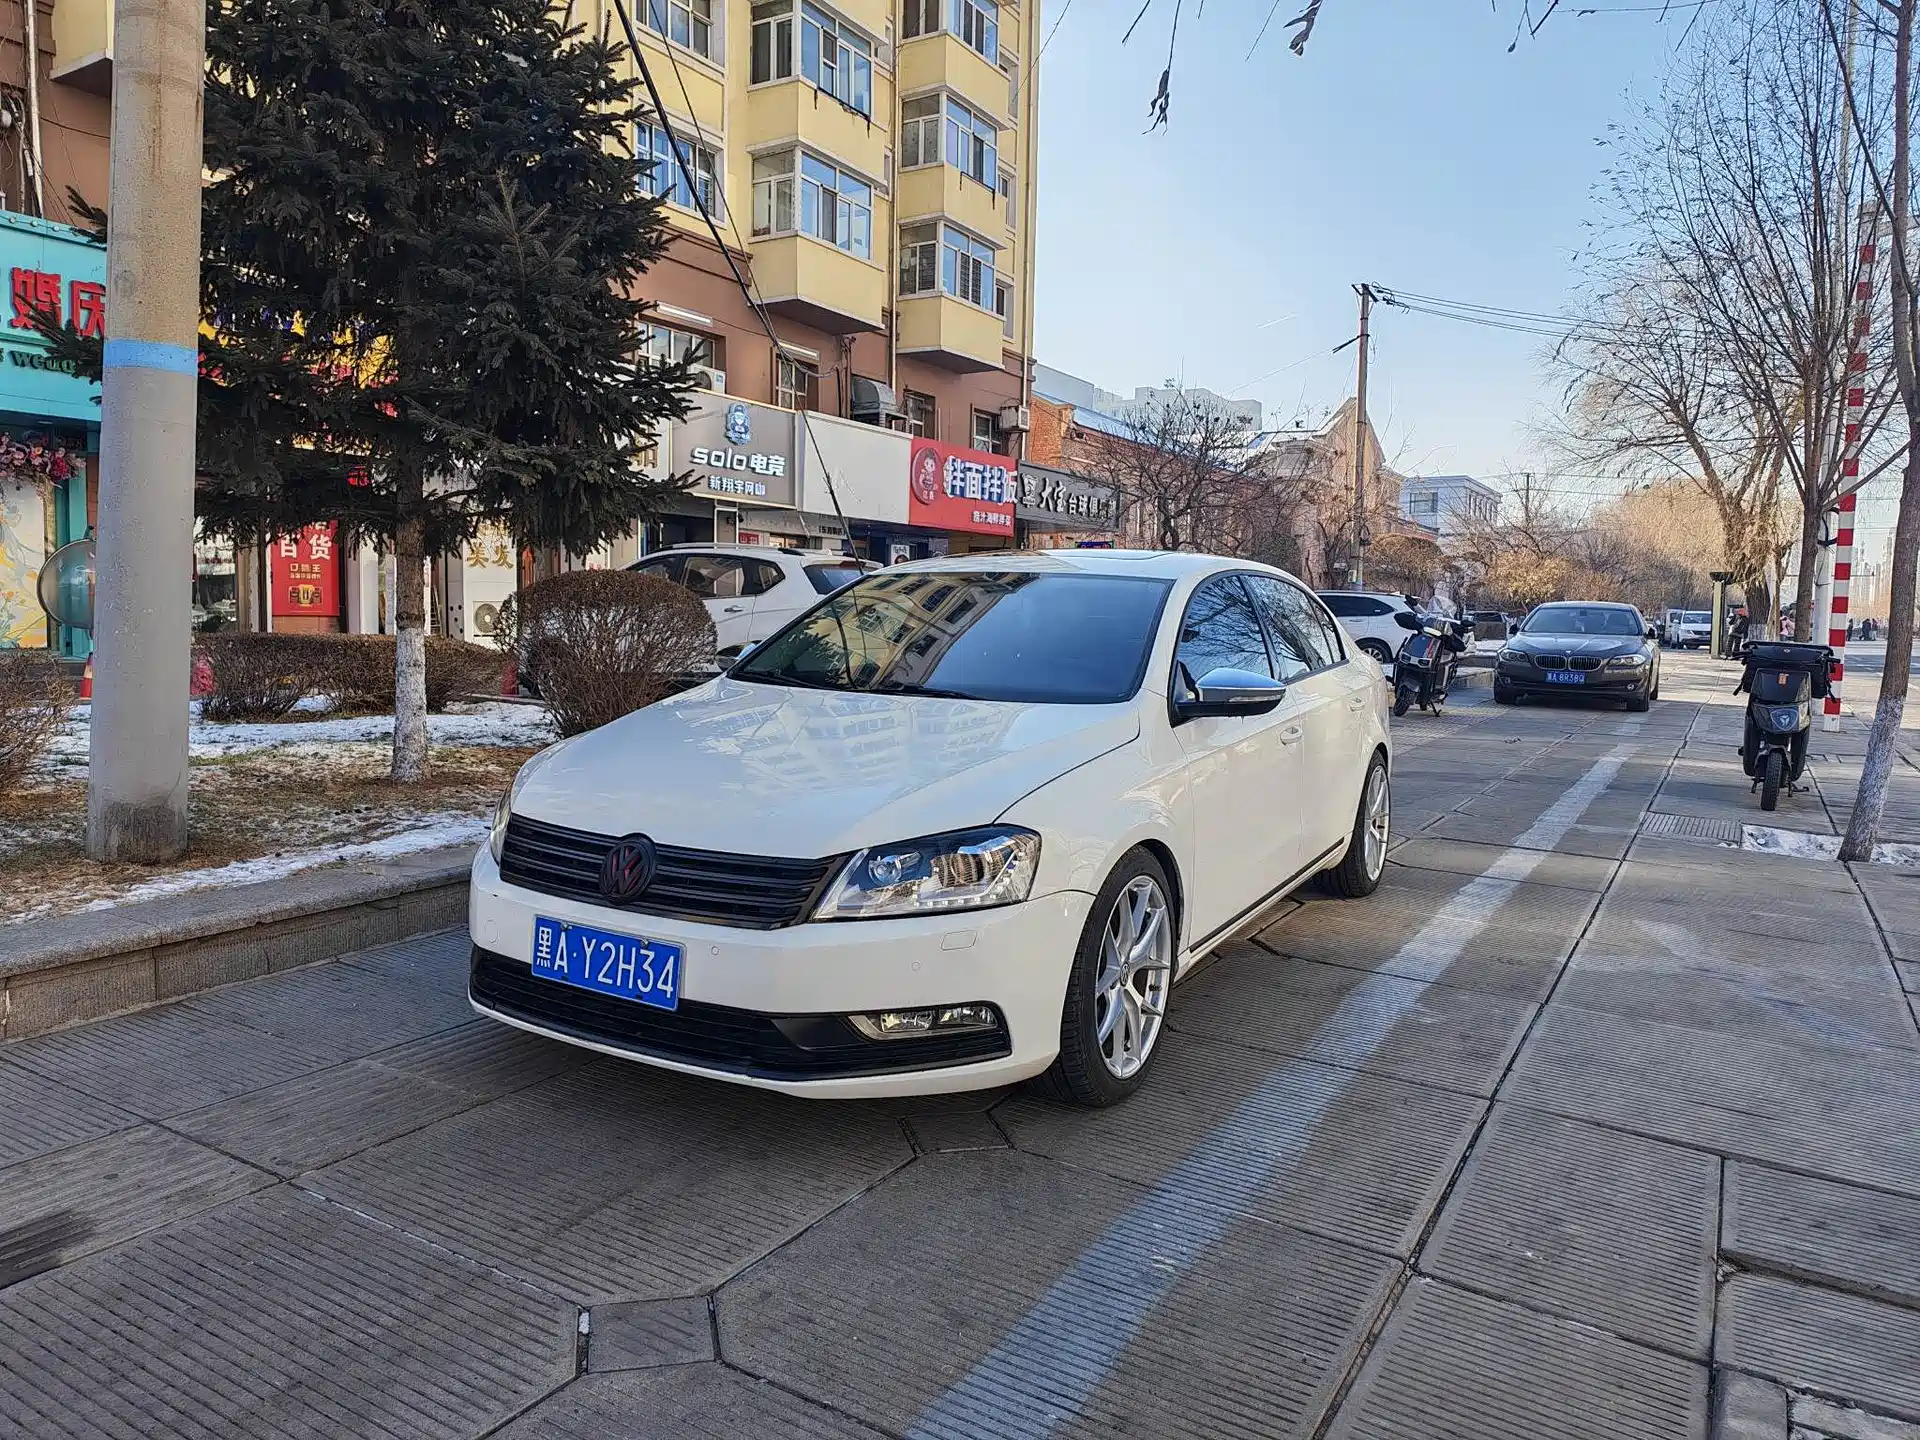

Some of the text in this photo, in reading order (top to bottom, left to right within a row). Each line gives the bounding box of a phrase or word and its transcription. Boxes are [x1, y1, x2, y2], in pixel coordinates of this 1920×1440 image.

[709, 475, 766, 496] 新翔宇网咖
[943, 455, 1018, 506] 拌面拌饭
